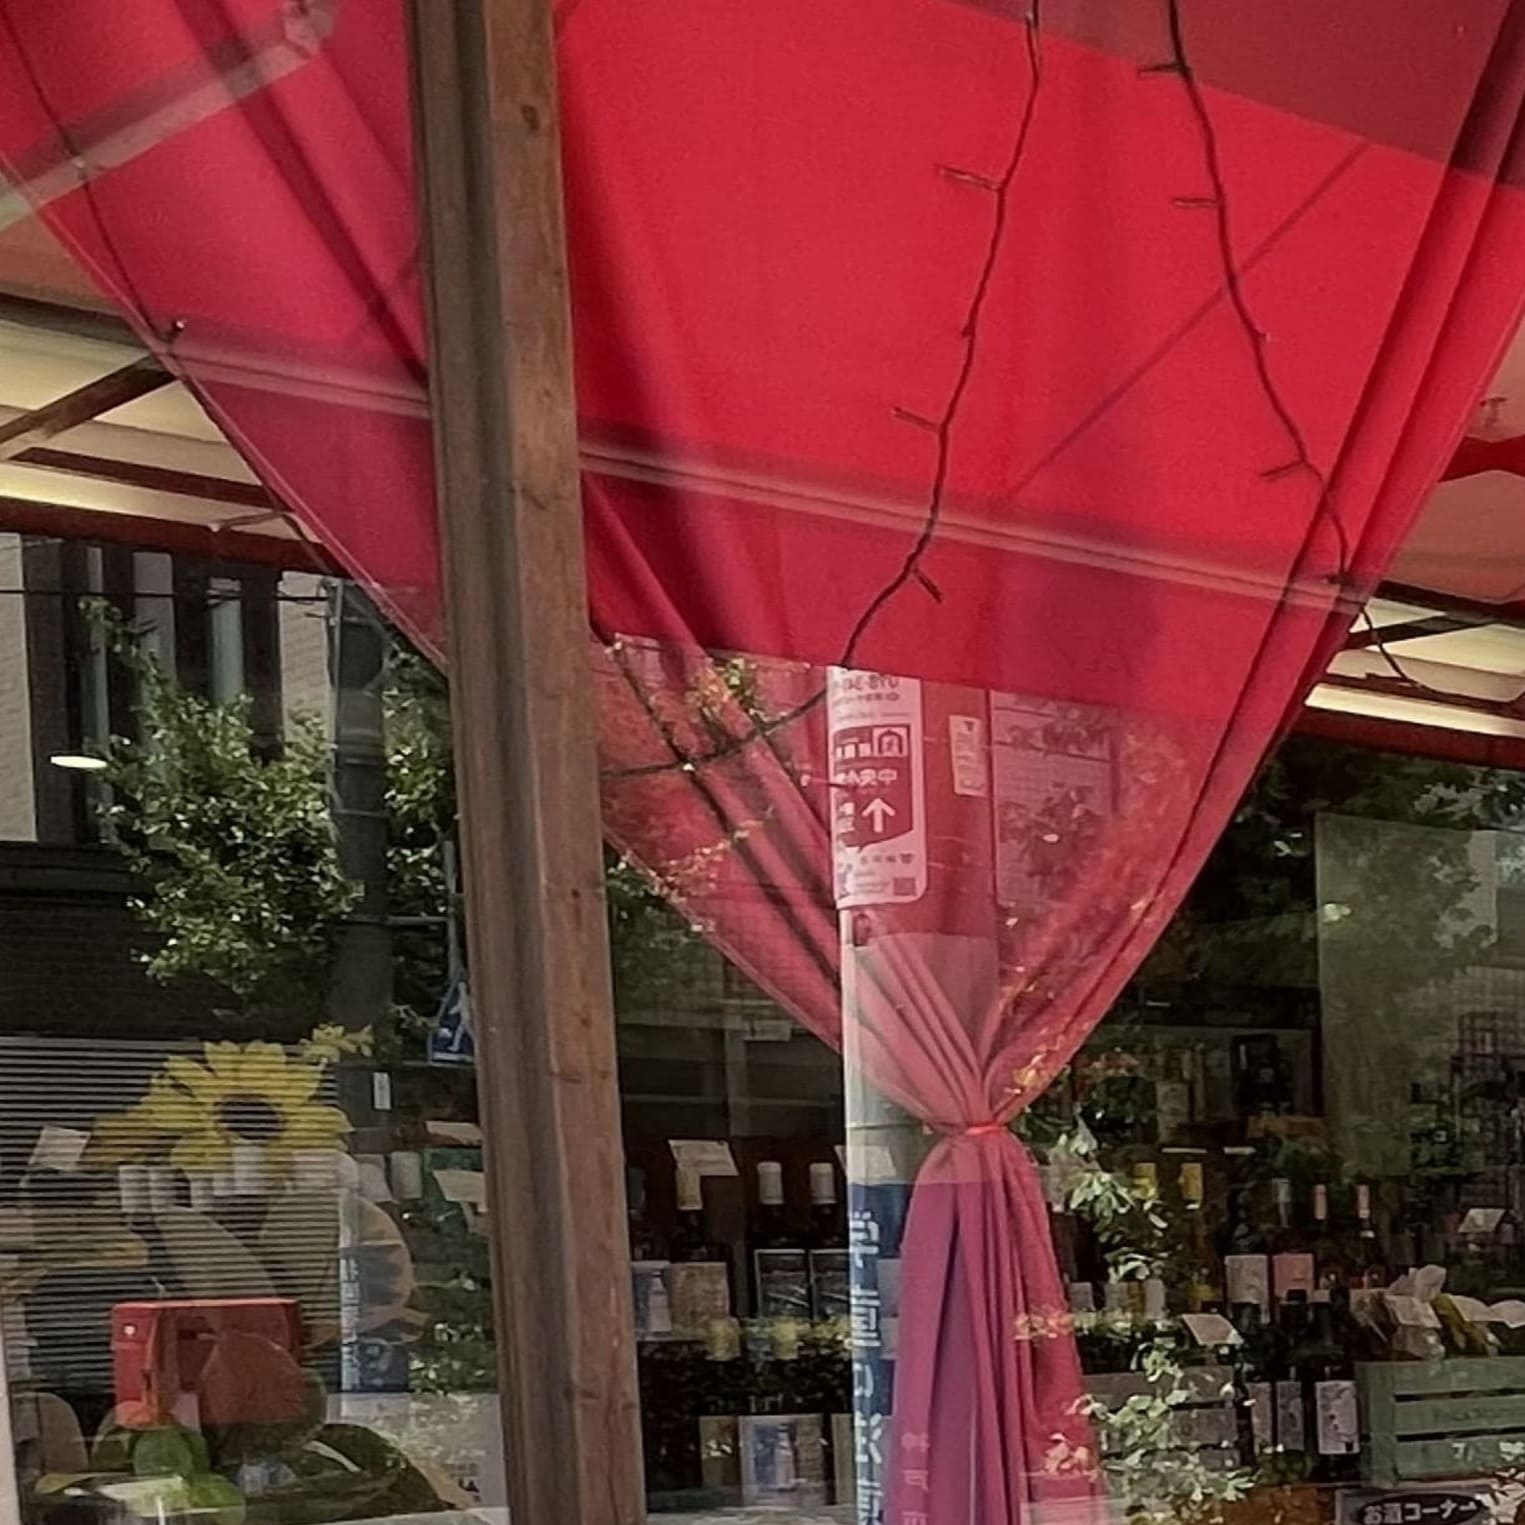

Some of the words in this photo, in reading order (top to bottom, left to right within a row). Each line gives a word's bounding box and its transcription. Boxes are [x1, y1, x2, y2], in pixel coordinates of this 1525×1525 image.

[1362, 1500, 1478, 1525] お酒コーナー
